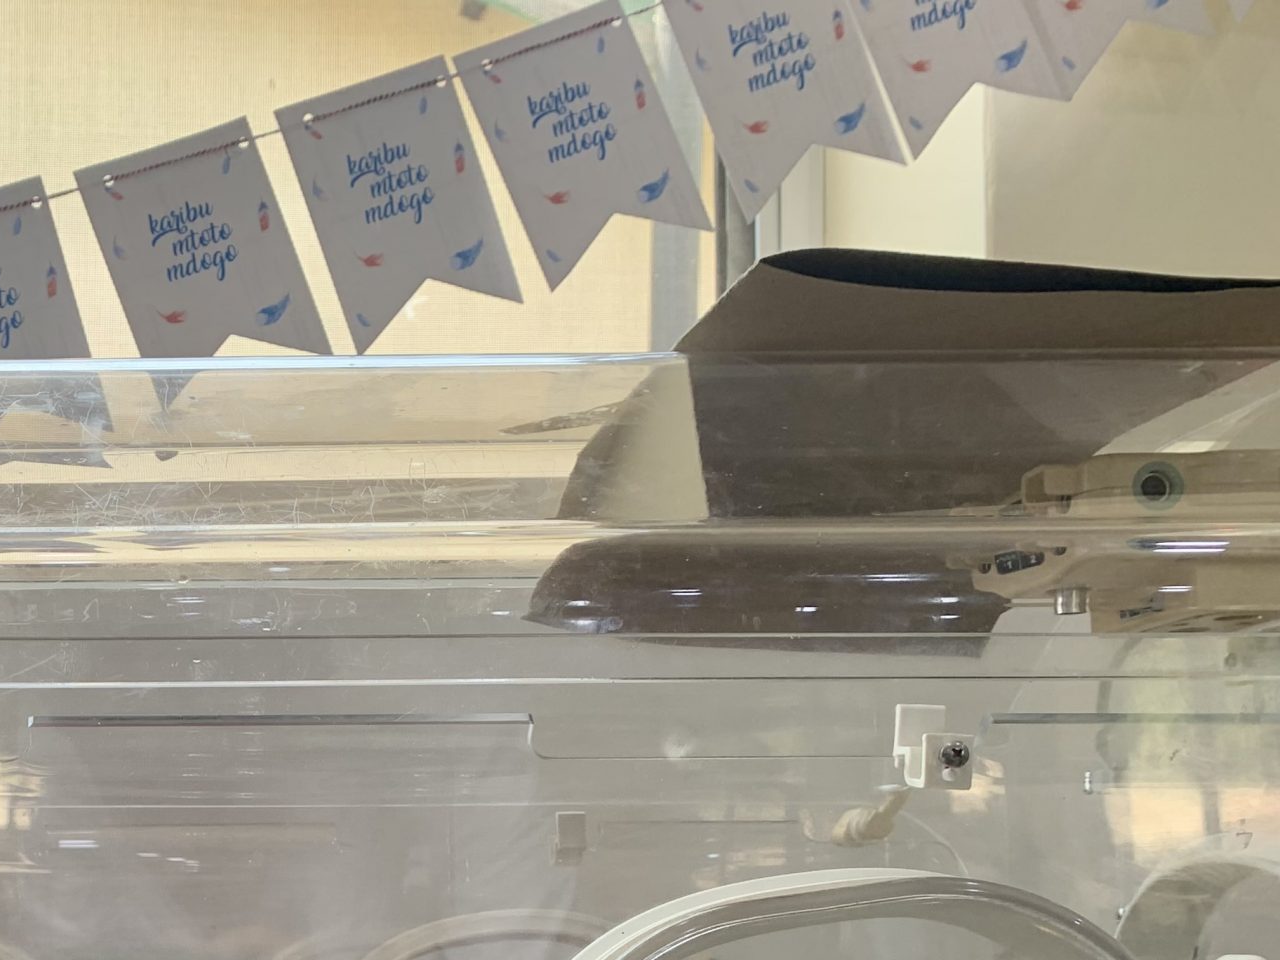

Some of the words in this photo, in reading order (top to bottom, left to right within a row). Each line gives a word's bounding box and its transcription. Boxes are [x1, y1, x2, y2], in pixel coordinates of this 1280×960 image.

[728, 11, 790, 57] karibu
[752, 32, 809, 67] mtoto
[748, 53, 816, 92] mdogo
[527, 82, 590, 128] karibu
[552, 102, 610, 137] mtoto
[548, 123, 617, 163] mdogo
[346, 142, 410, 188] karibu
[370, 164, 429, 199] mtoto
[148, 201, 213, 247] karibu
[365, 187, 435, 224] mdogo
[172, 222, 233, 256] mtoto
[167, 244, 239, 282] mdogo
